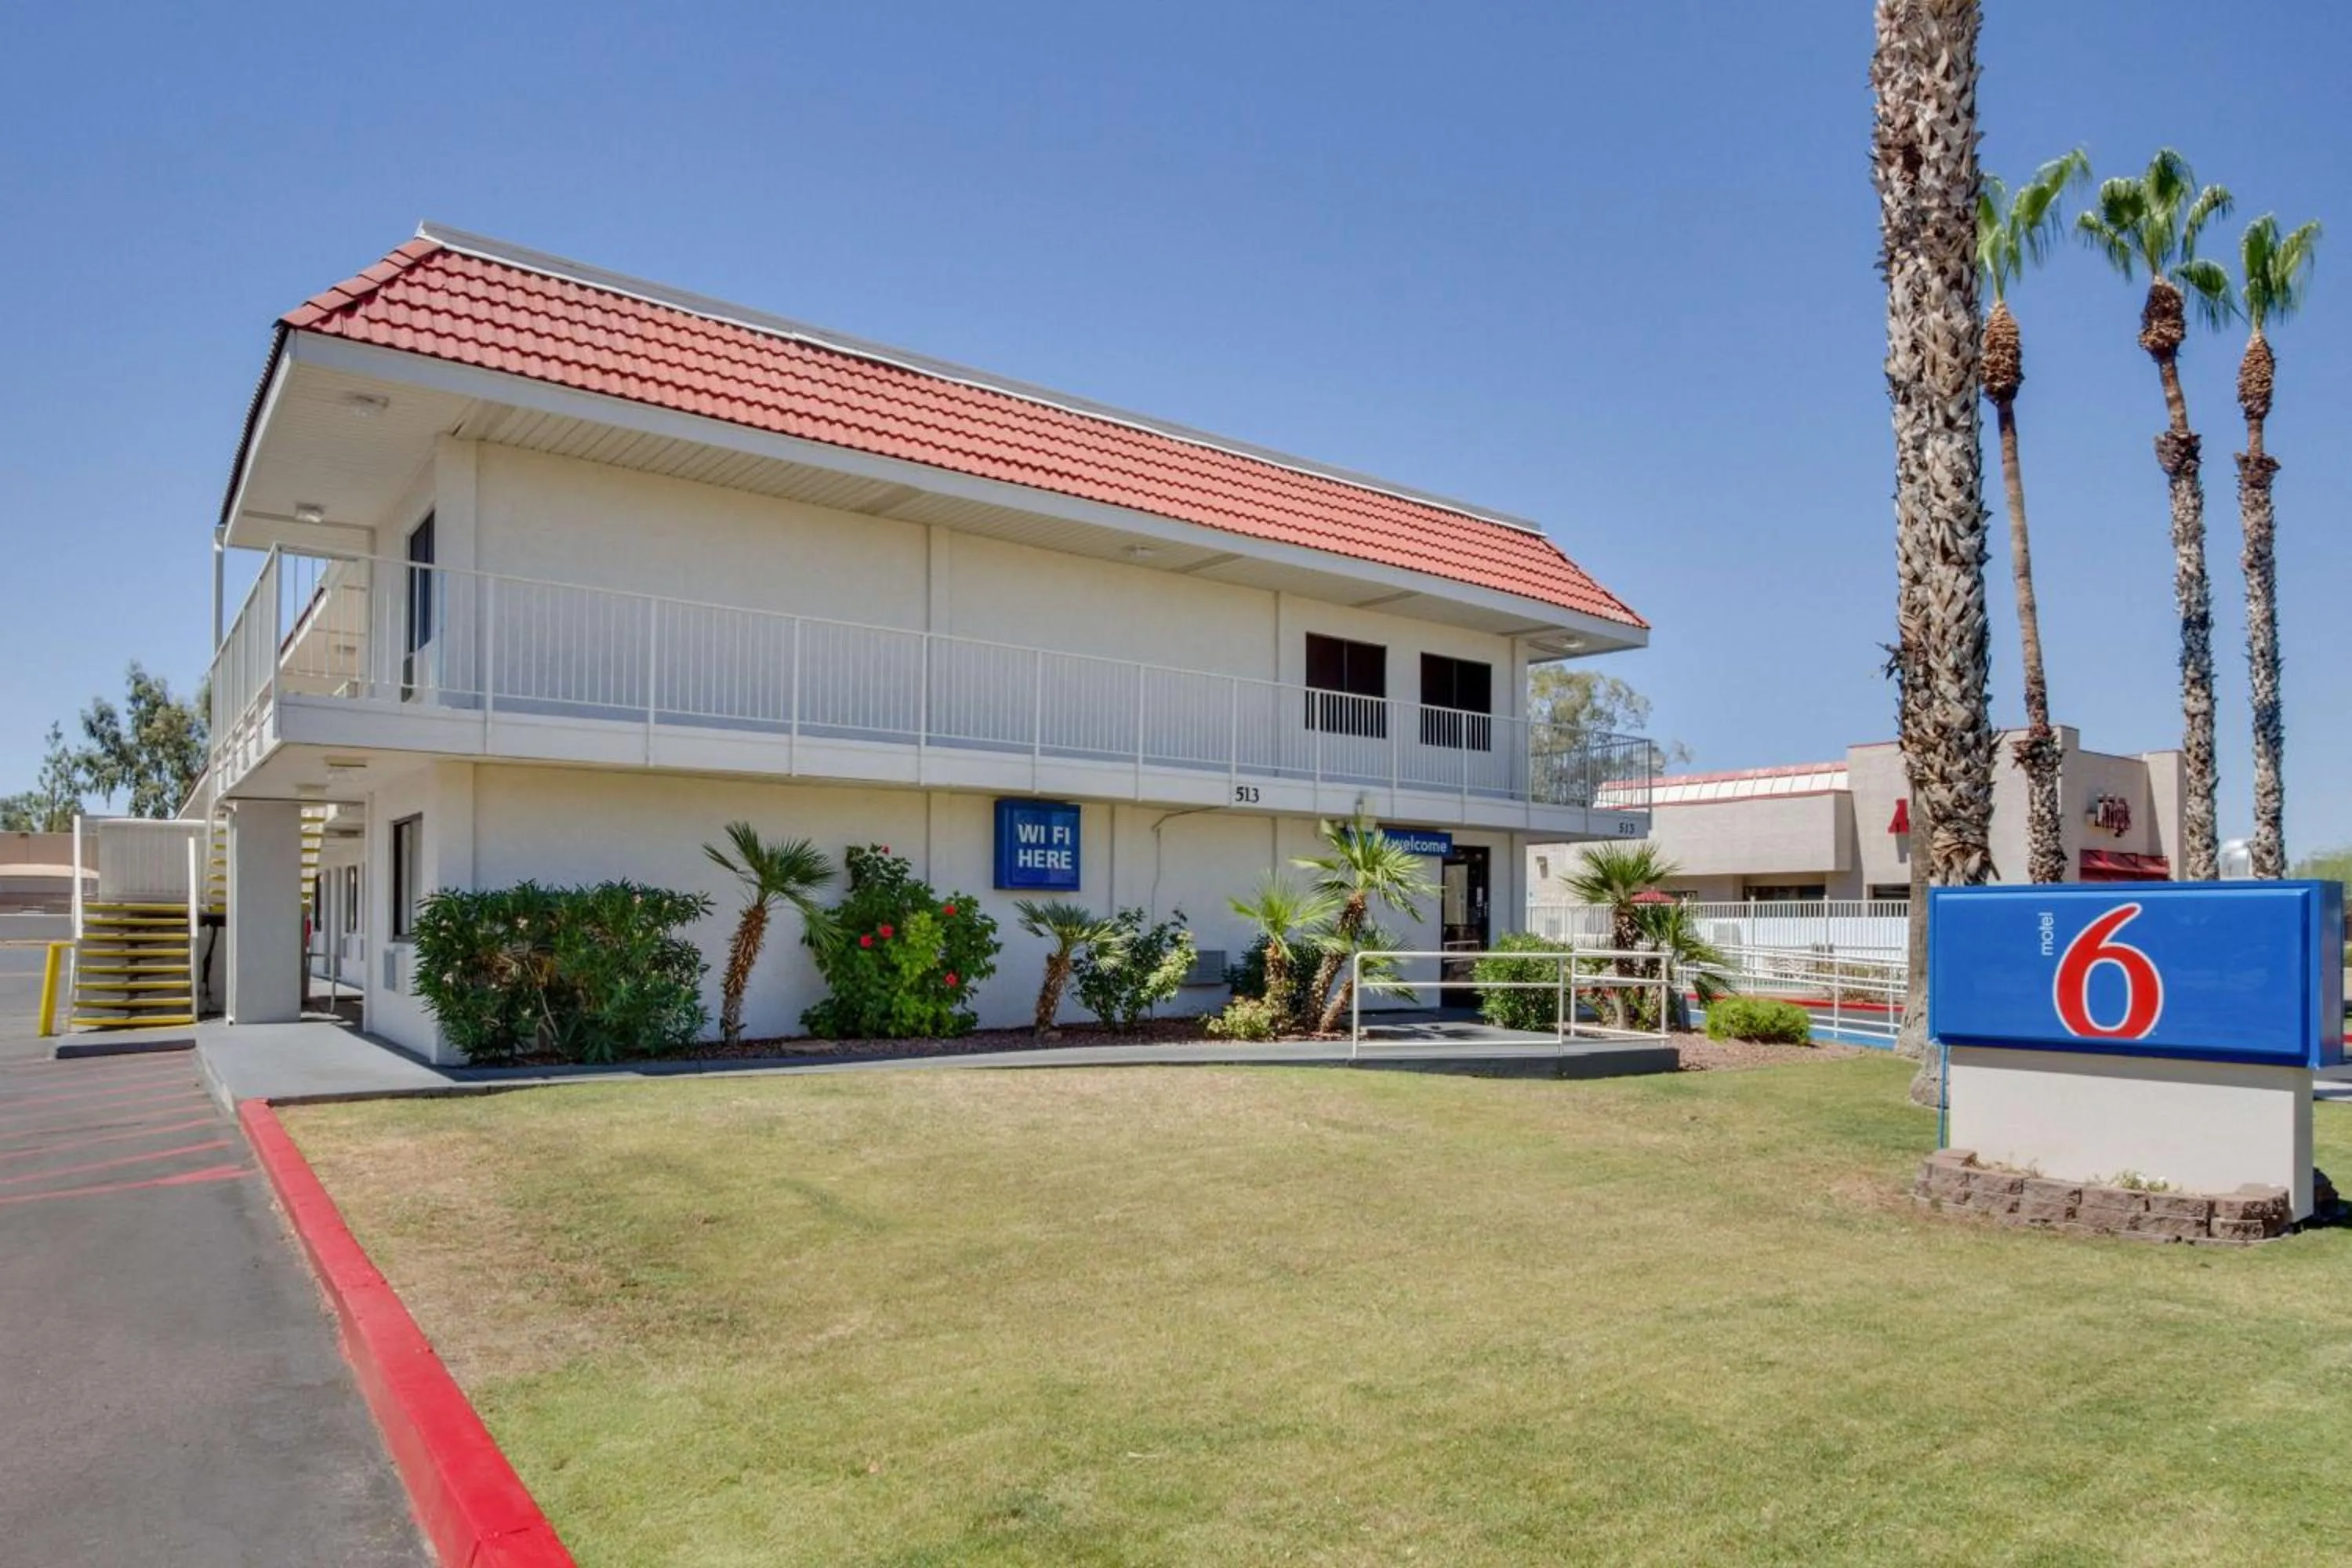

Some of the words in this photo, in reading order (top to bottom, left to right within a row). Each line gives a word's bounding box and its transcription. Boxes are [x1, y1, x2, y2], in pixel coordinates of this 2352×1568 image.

[1235, 786, 1260, 804] 513
[1018, 823, 1046, 844] WI
[1052, 825, 1071, 845] FI
[1619, 822, 1635, 834] 513
[1390, 834, 1447, 854] welcome
[1018, 848, 1073, 870] HERE
[2038, 912, 2054, 956] motel
[2053, 902, 2165, 1041] 6
